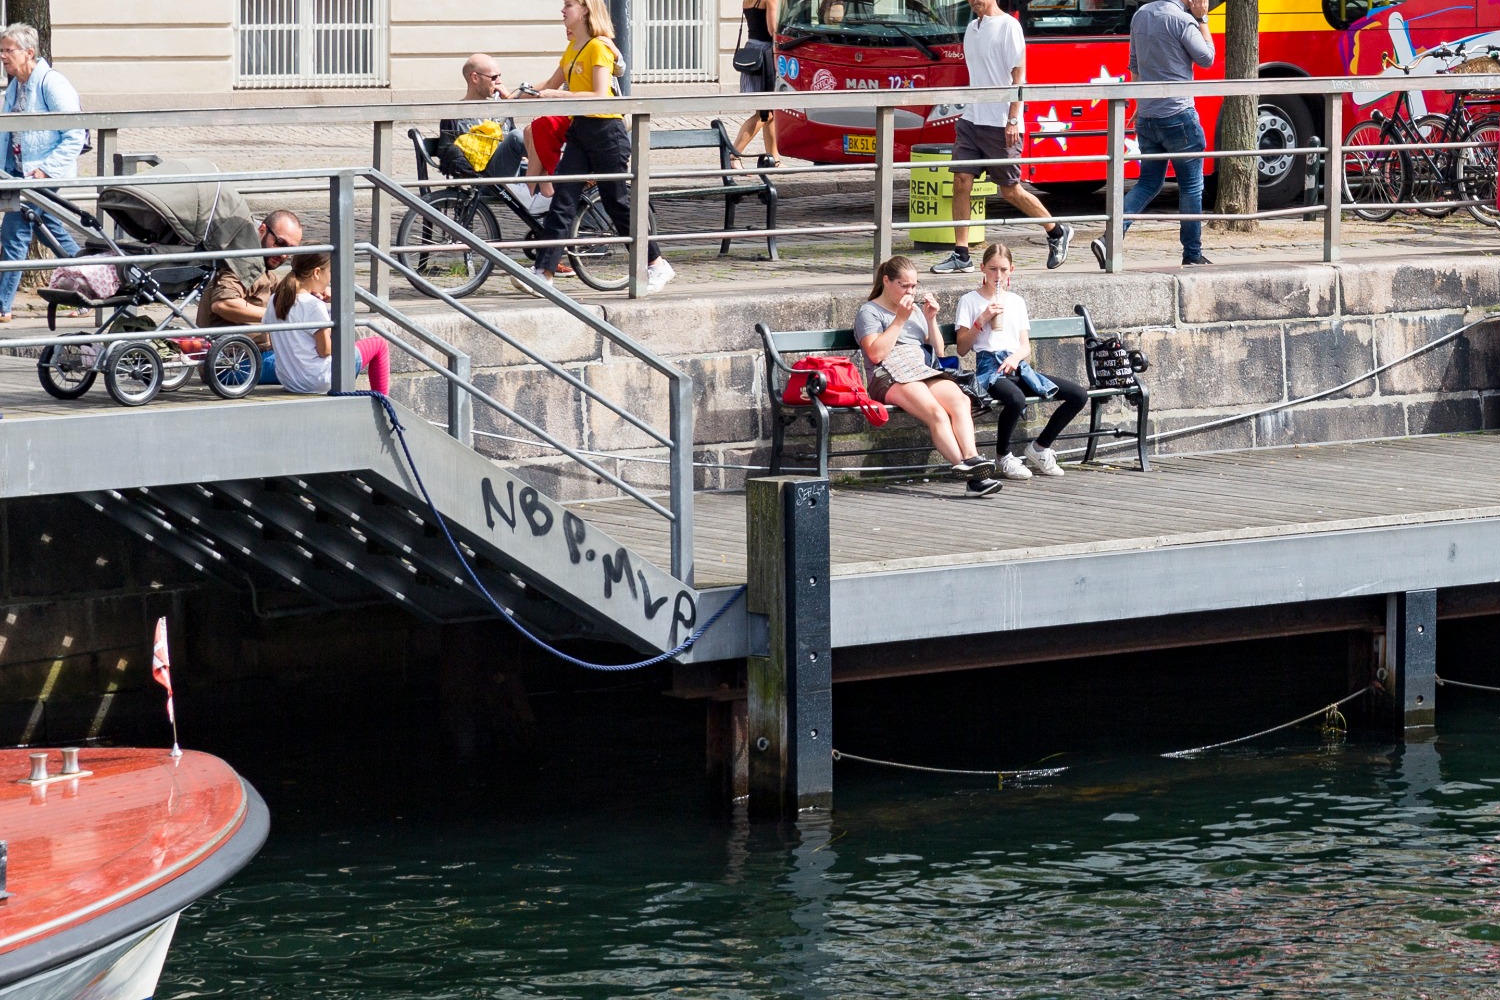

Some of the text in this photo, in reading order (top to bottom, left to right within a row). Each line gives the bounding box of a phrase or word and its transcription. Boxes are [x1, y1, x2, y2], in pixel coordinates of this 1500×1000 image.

[845, 78, 879, 90] MAN
[848, 138, 859, 150] BK
[860, 138, 870, 151] 51
[910, 180, 938, 196] REN
[910, 199, 938, 216] KBH
